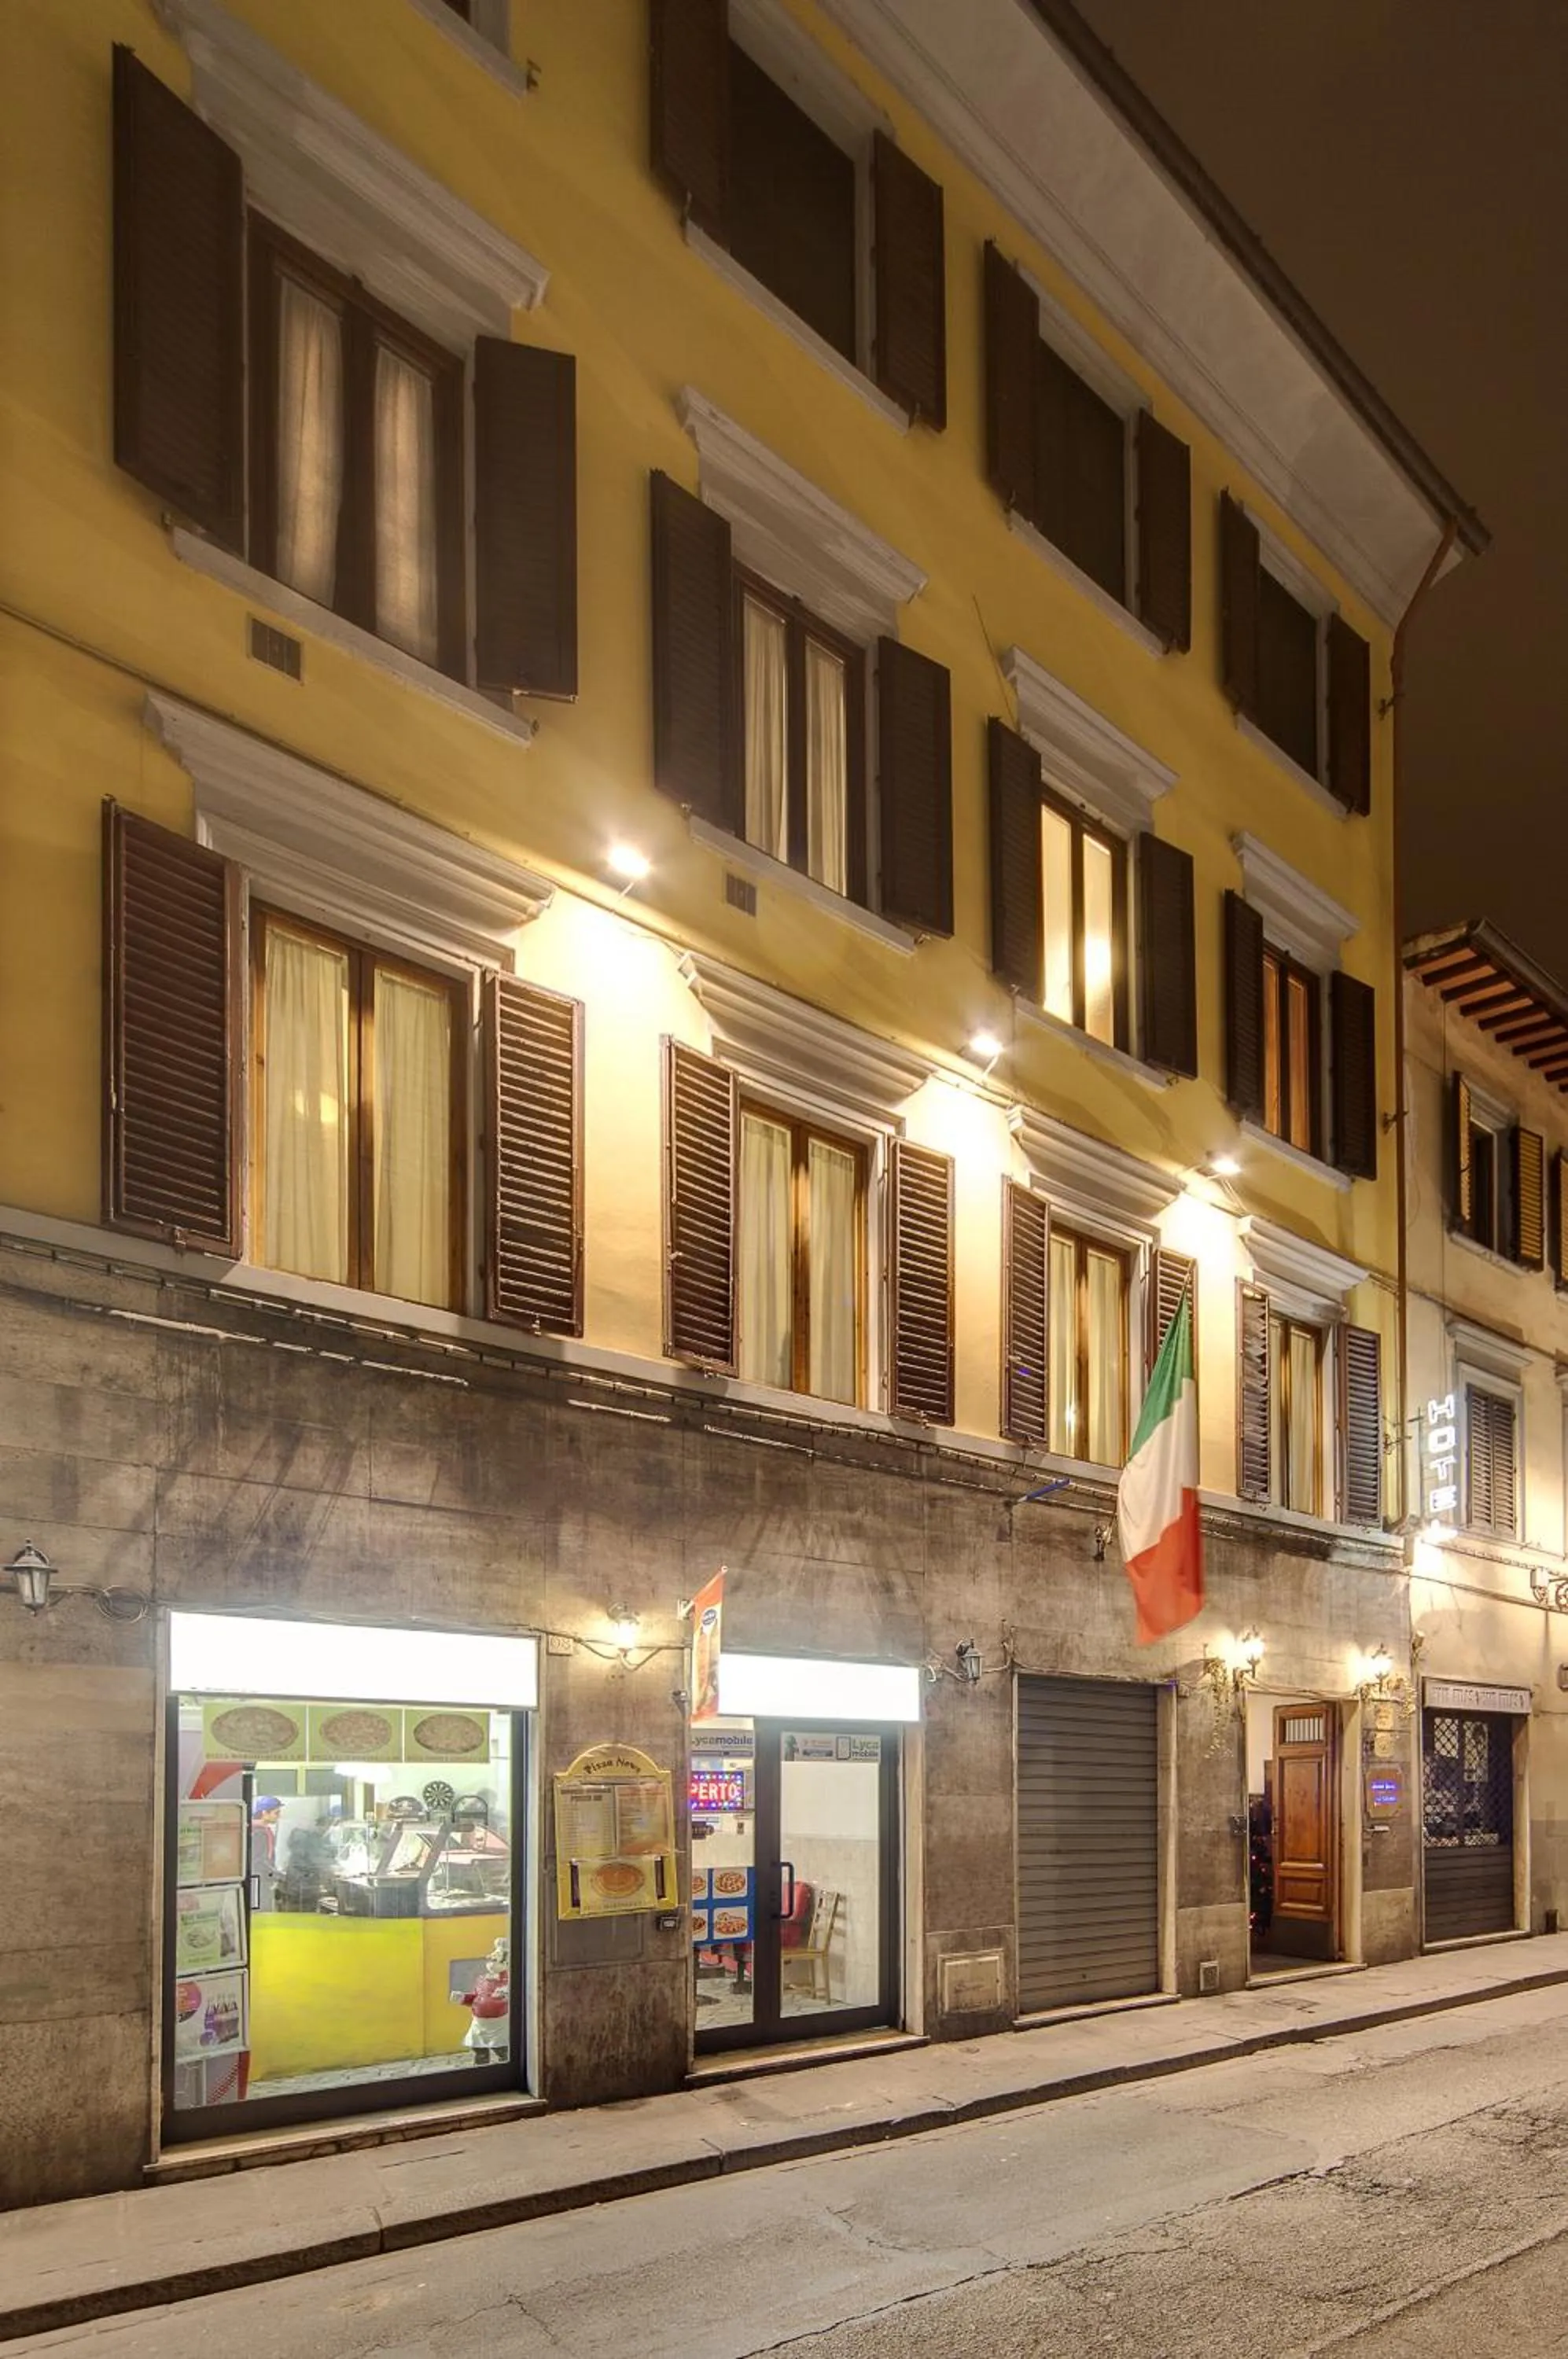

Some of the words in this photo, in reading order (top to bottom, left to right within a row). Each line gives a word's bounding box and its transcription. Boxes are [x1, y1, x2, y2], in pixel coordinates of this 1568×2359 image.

[691, 1735, 753, 1746] ycamobile
[852, 1739, 879, 1750] Lyca
[690, 1782, 738, 1801] PERTO
